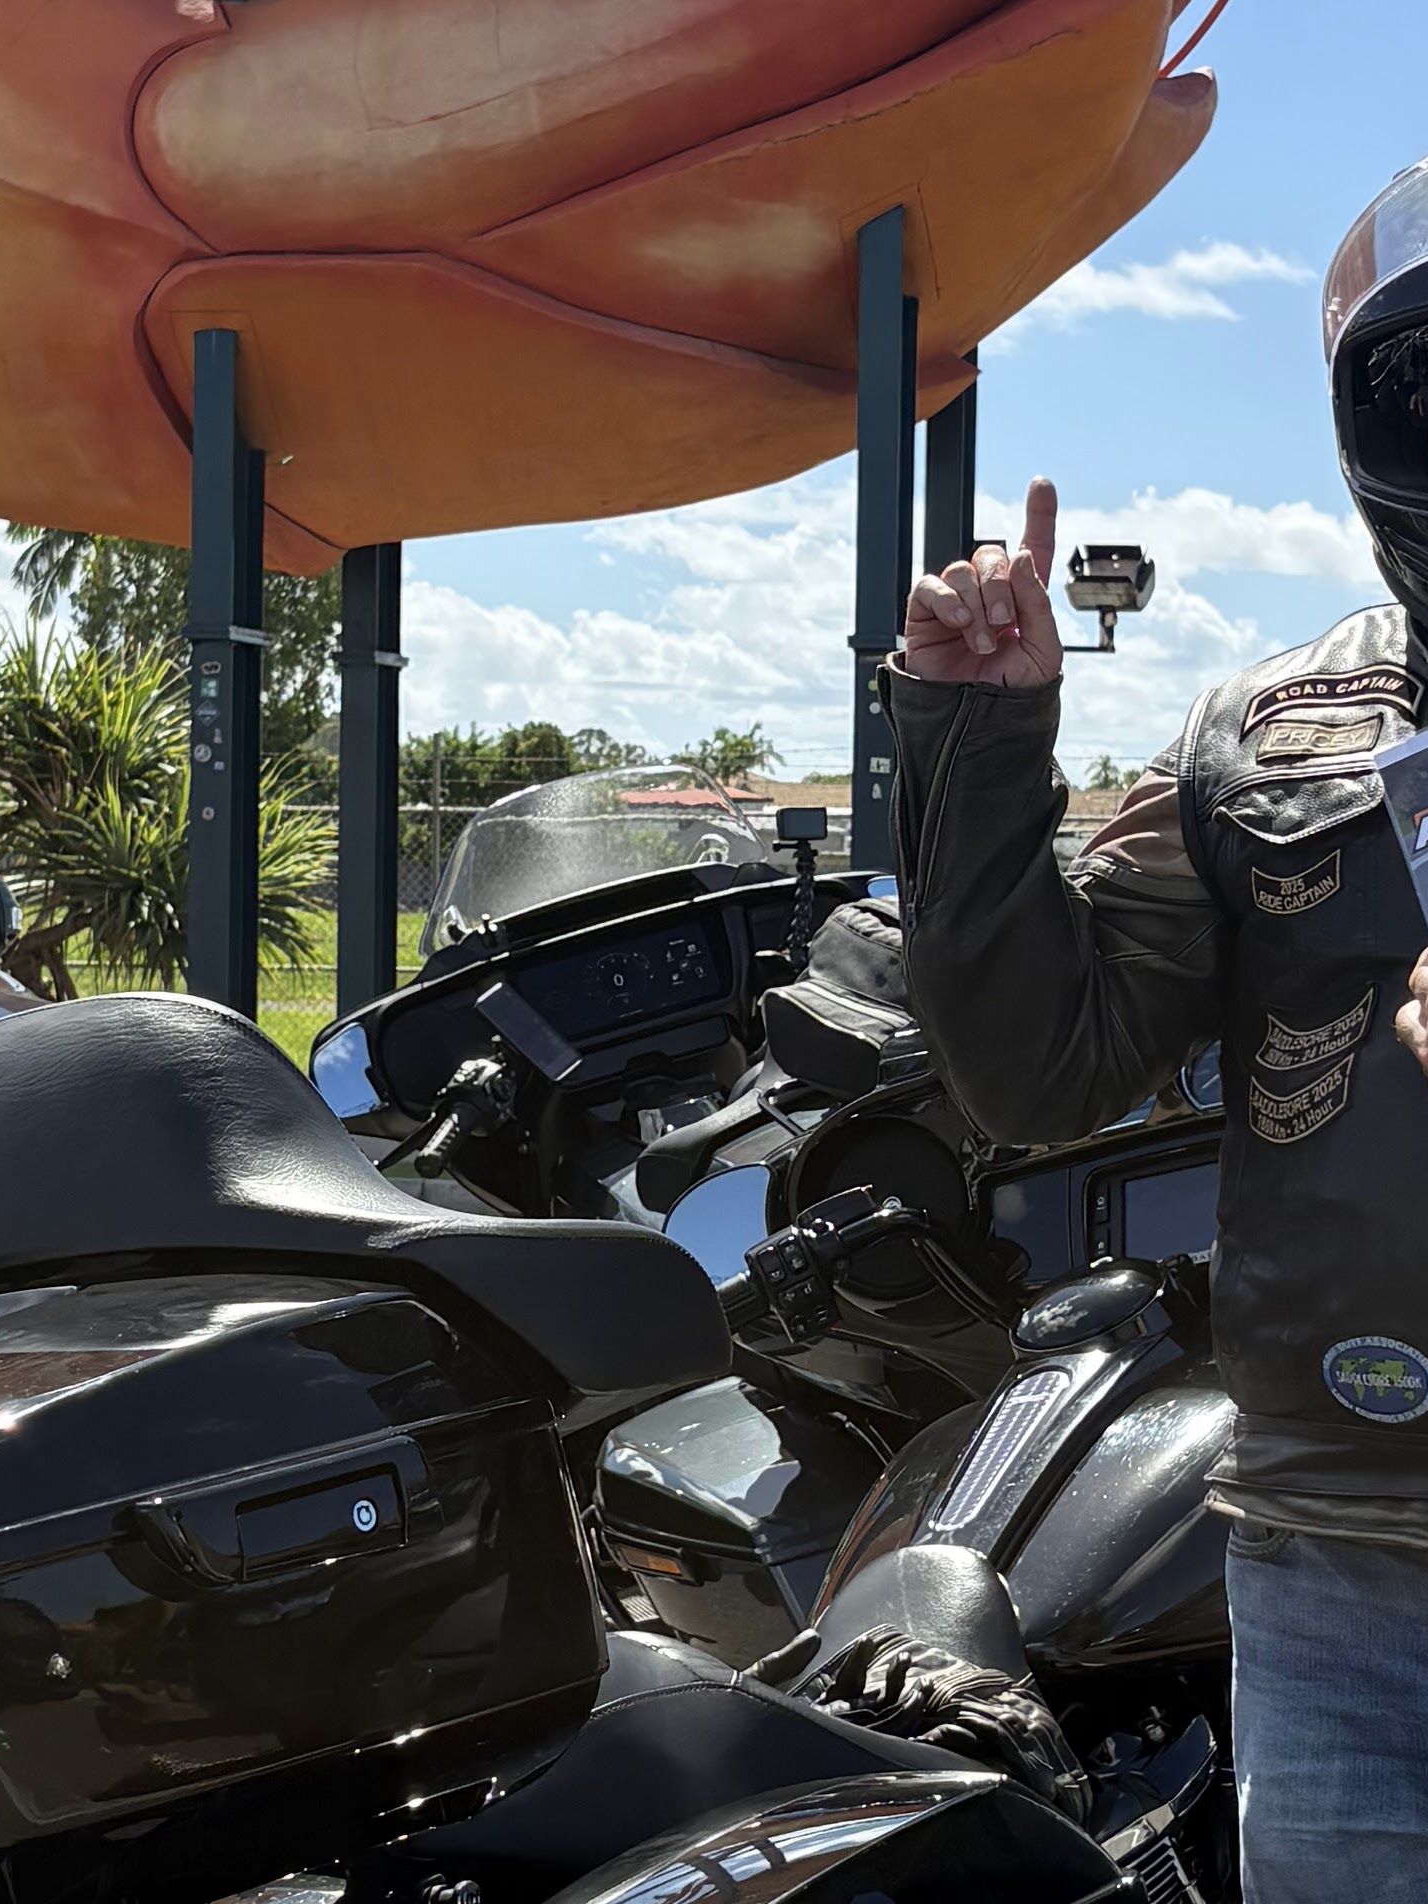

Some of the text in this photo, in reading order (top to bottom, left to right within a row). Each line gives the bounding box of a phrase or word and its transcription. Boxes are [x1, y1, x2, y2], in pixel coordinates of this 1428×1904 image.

[1275, 674, 1405, 701] ROAD CAPTAIN
[1271, 728, 1366, 747] PRICEY
[1279, 878, 1306, 895] 2025
[1283, 875, 1336, 911] CAPTAIN
[1319, 1032, 1352, 1056] Hour
[1311, 1069, 1343, 1103] 2025
[1292, 1117, 1307, 1135] 24
[1305, 1097, 1335, 1127] Hour
